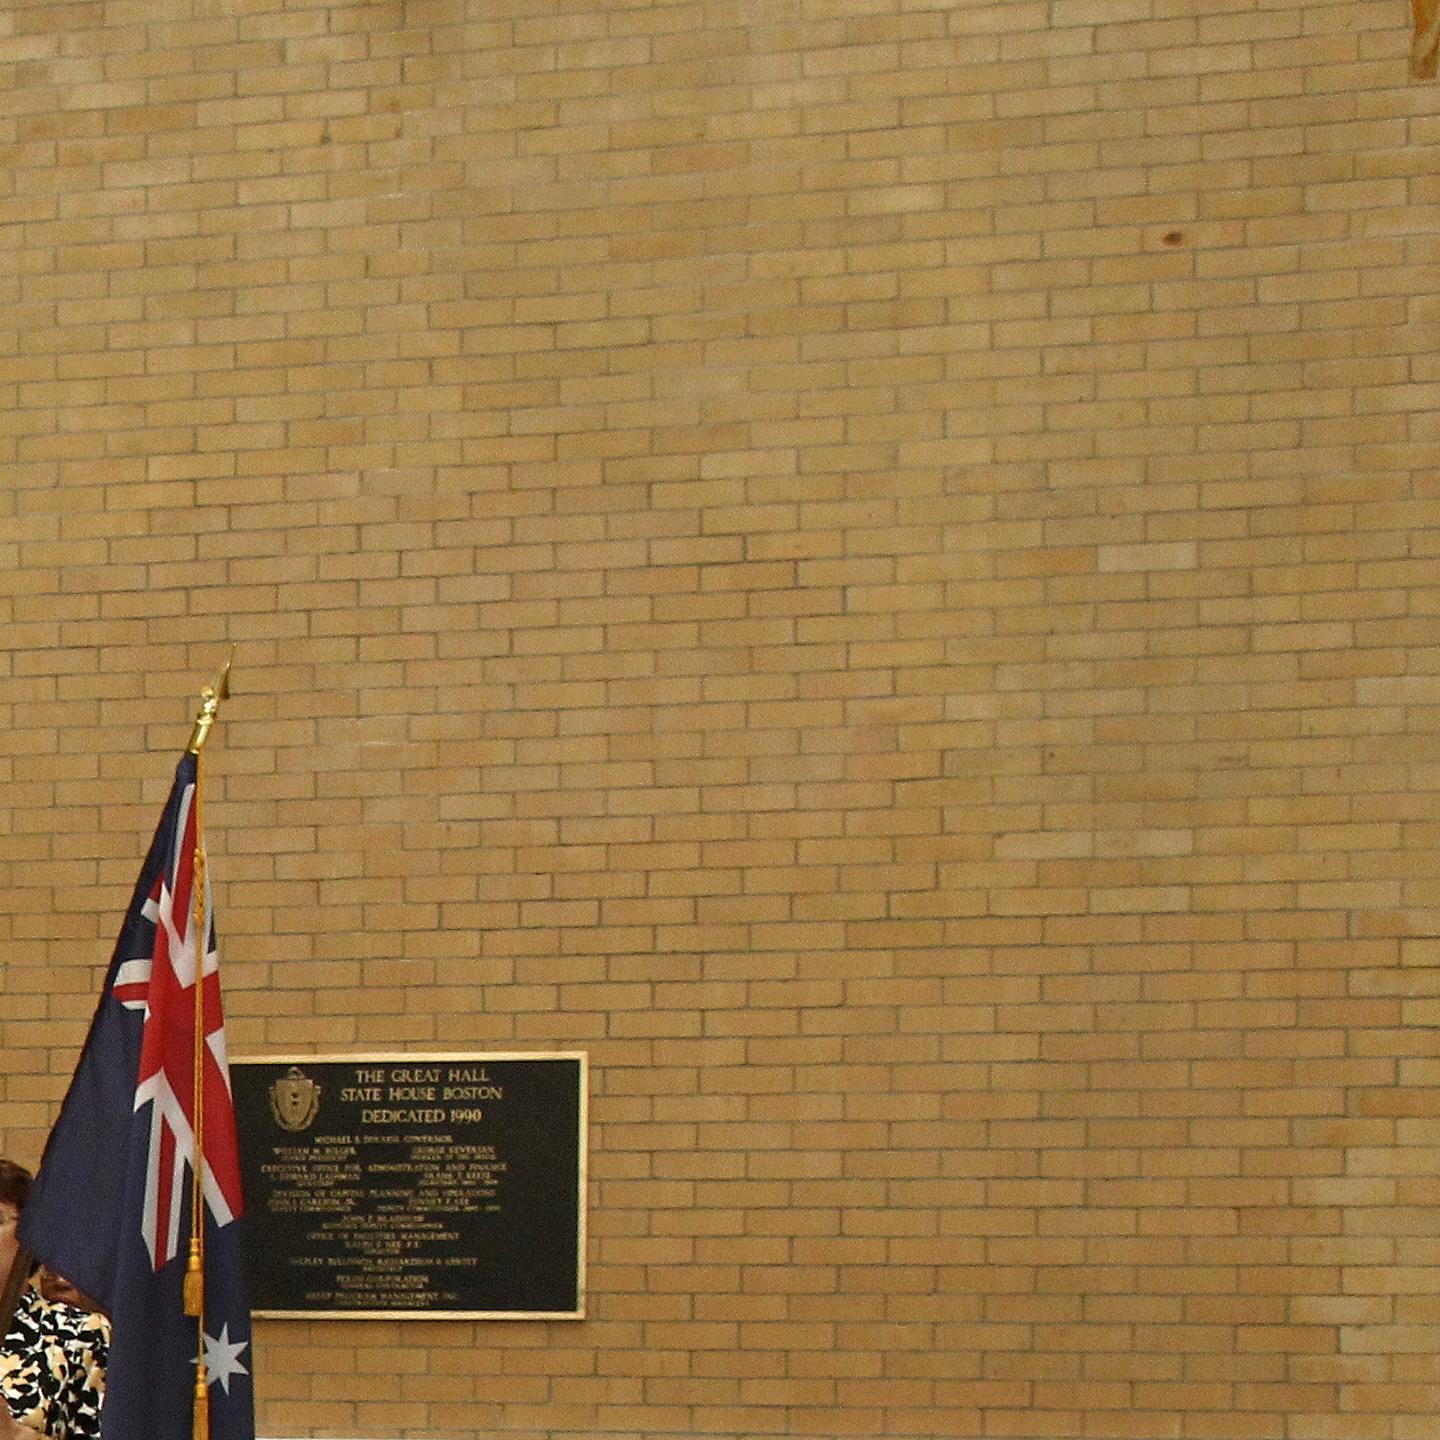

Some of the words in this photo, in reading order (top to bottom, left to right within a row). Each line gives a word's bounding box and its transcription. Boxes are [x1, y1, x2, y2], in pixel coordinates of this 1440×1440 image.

[355, 1070, 385, 1083] THE
[391, 1069, 441, 1083] GREAT
[448, 1068, 490, 1082] HALL
[340, 1087, 382, 1102] STATE
[388, 1087, 436, 1101] HOUSE
[443, 1087, 503, 1100] BOSTON
[362, 1109, 446, 1123] DEDICATED
[451, 1108, 482, 1123] 1990
